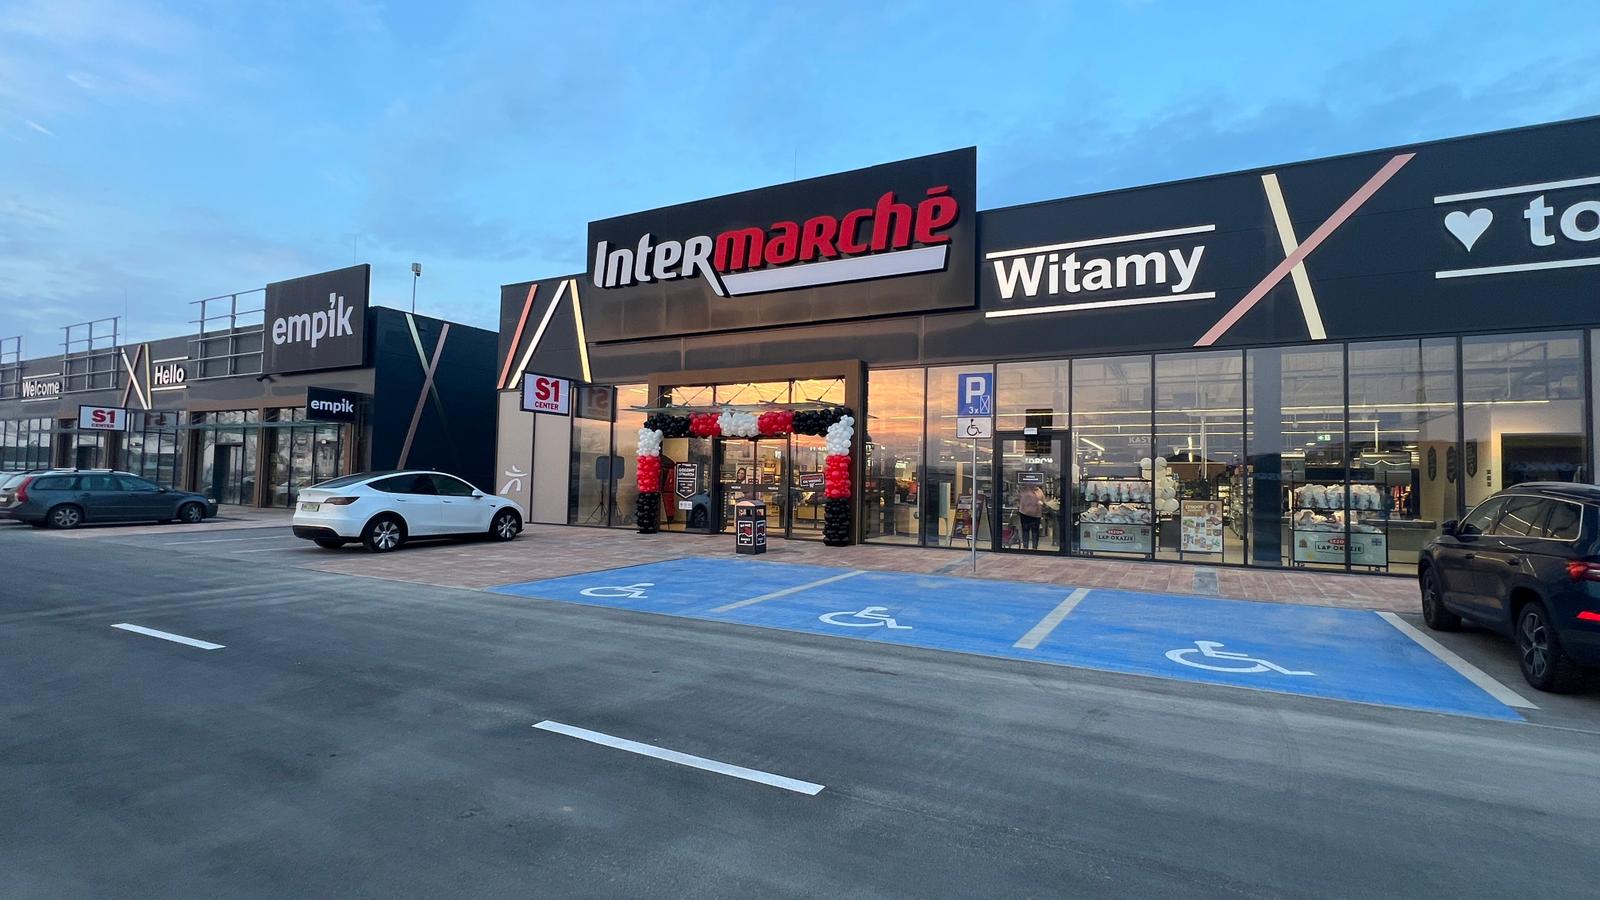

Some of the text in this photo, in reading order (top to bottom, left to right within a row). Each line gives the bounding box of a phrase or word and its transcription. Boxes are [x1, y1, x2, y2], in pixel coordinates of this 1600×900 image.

[993, 245, 1206, 300] Witamy
[272, 292, 354, 348] empik
[154, 364, 185, 385] Hello
[22, 380, 60, 398] Welcome
[535, 378, 559, 402] S1
[965, 376, 986, 404] P
[91, 409, 116, 423] S1
[310, 399, 354, 414] empik
[534, 402, 559, 410] CENTER
